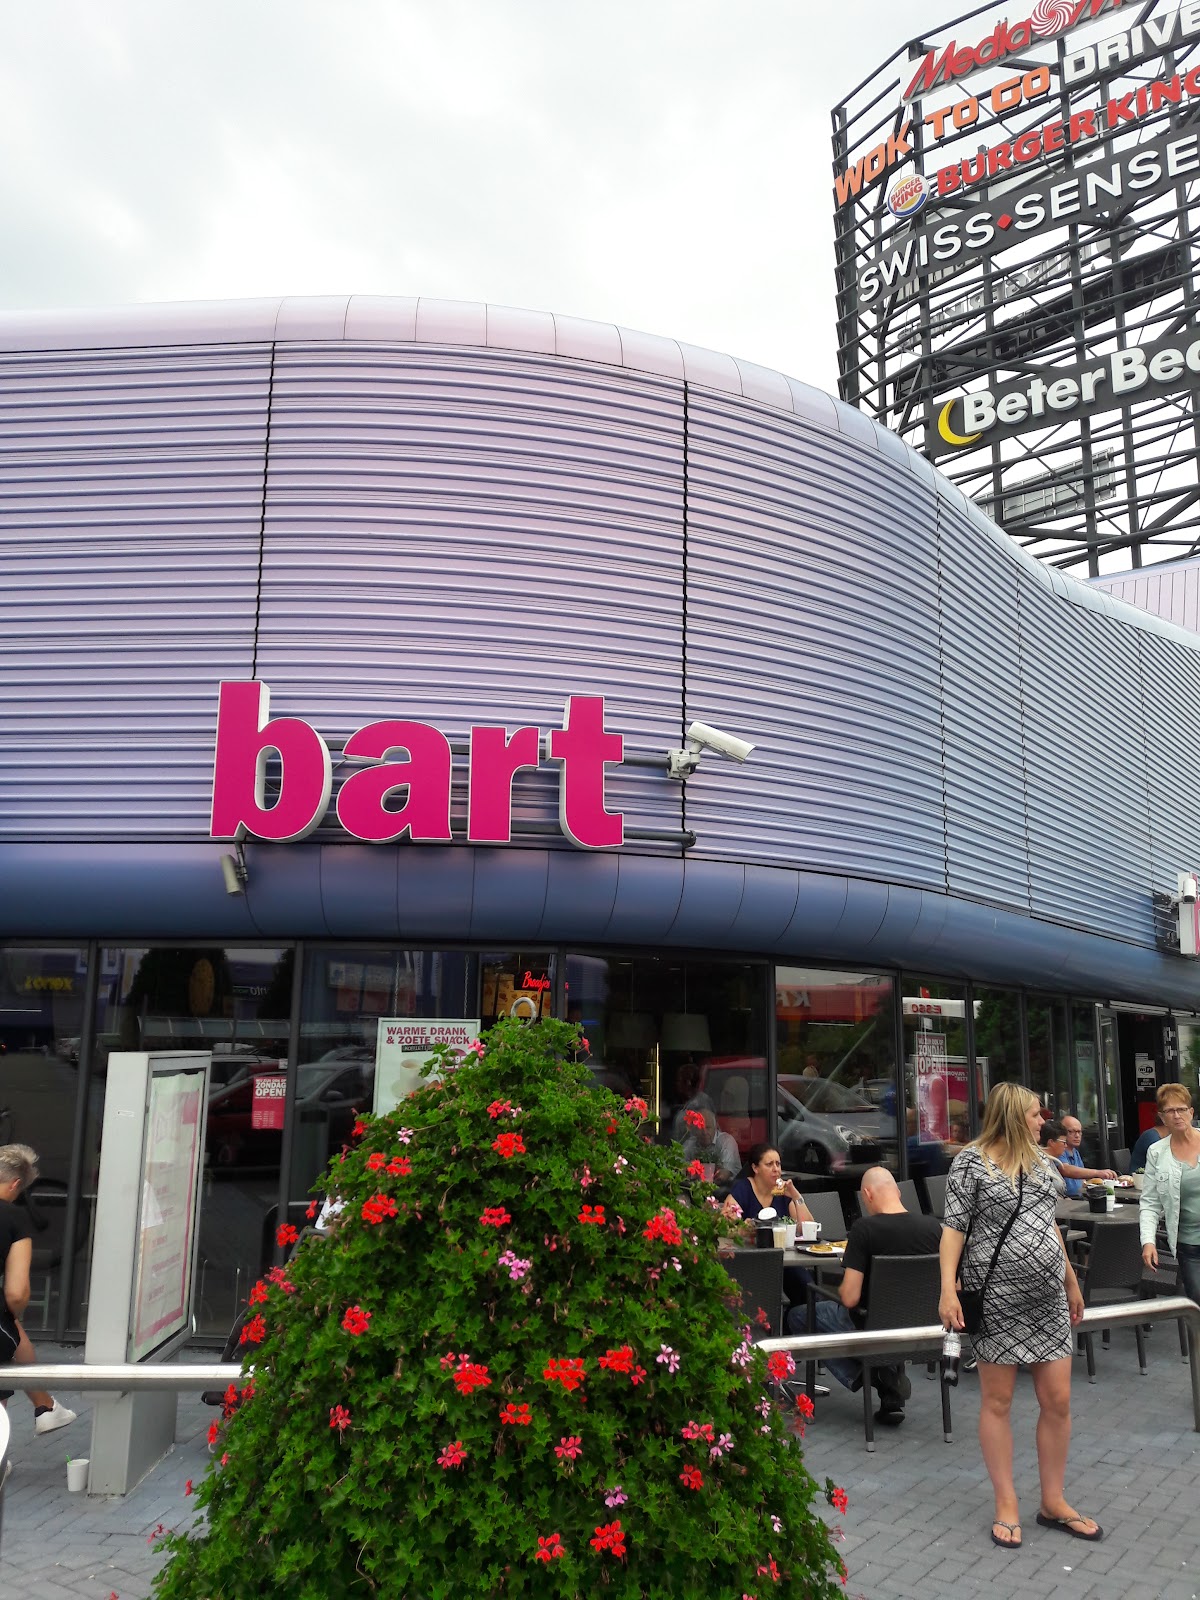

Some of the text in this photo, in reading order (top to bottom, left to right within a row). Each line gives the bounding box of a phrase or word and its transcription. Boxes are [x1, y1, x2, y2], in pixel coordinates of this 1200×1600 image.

[834, 65, 1050, 207] WOK TO GO
[937, 109, 1097, 196] BURGER
[891, 176, 921, 202] BURGER
[893, 183, 923, 213] KING
[859, 212, 995, 302] SWISS
[1014, 134, 1200, 230] SENSE
[209, 680, 624, 848] bart
[386, 1036, 470, 1045] & ZOETE SNACK
[387, 1026, 467, 1036] WARME DRANK
[918, 1044, 944, 1056] ZONDAG
[255, 1089, 286, 1097] OPEN!
